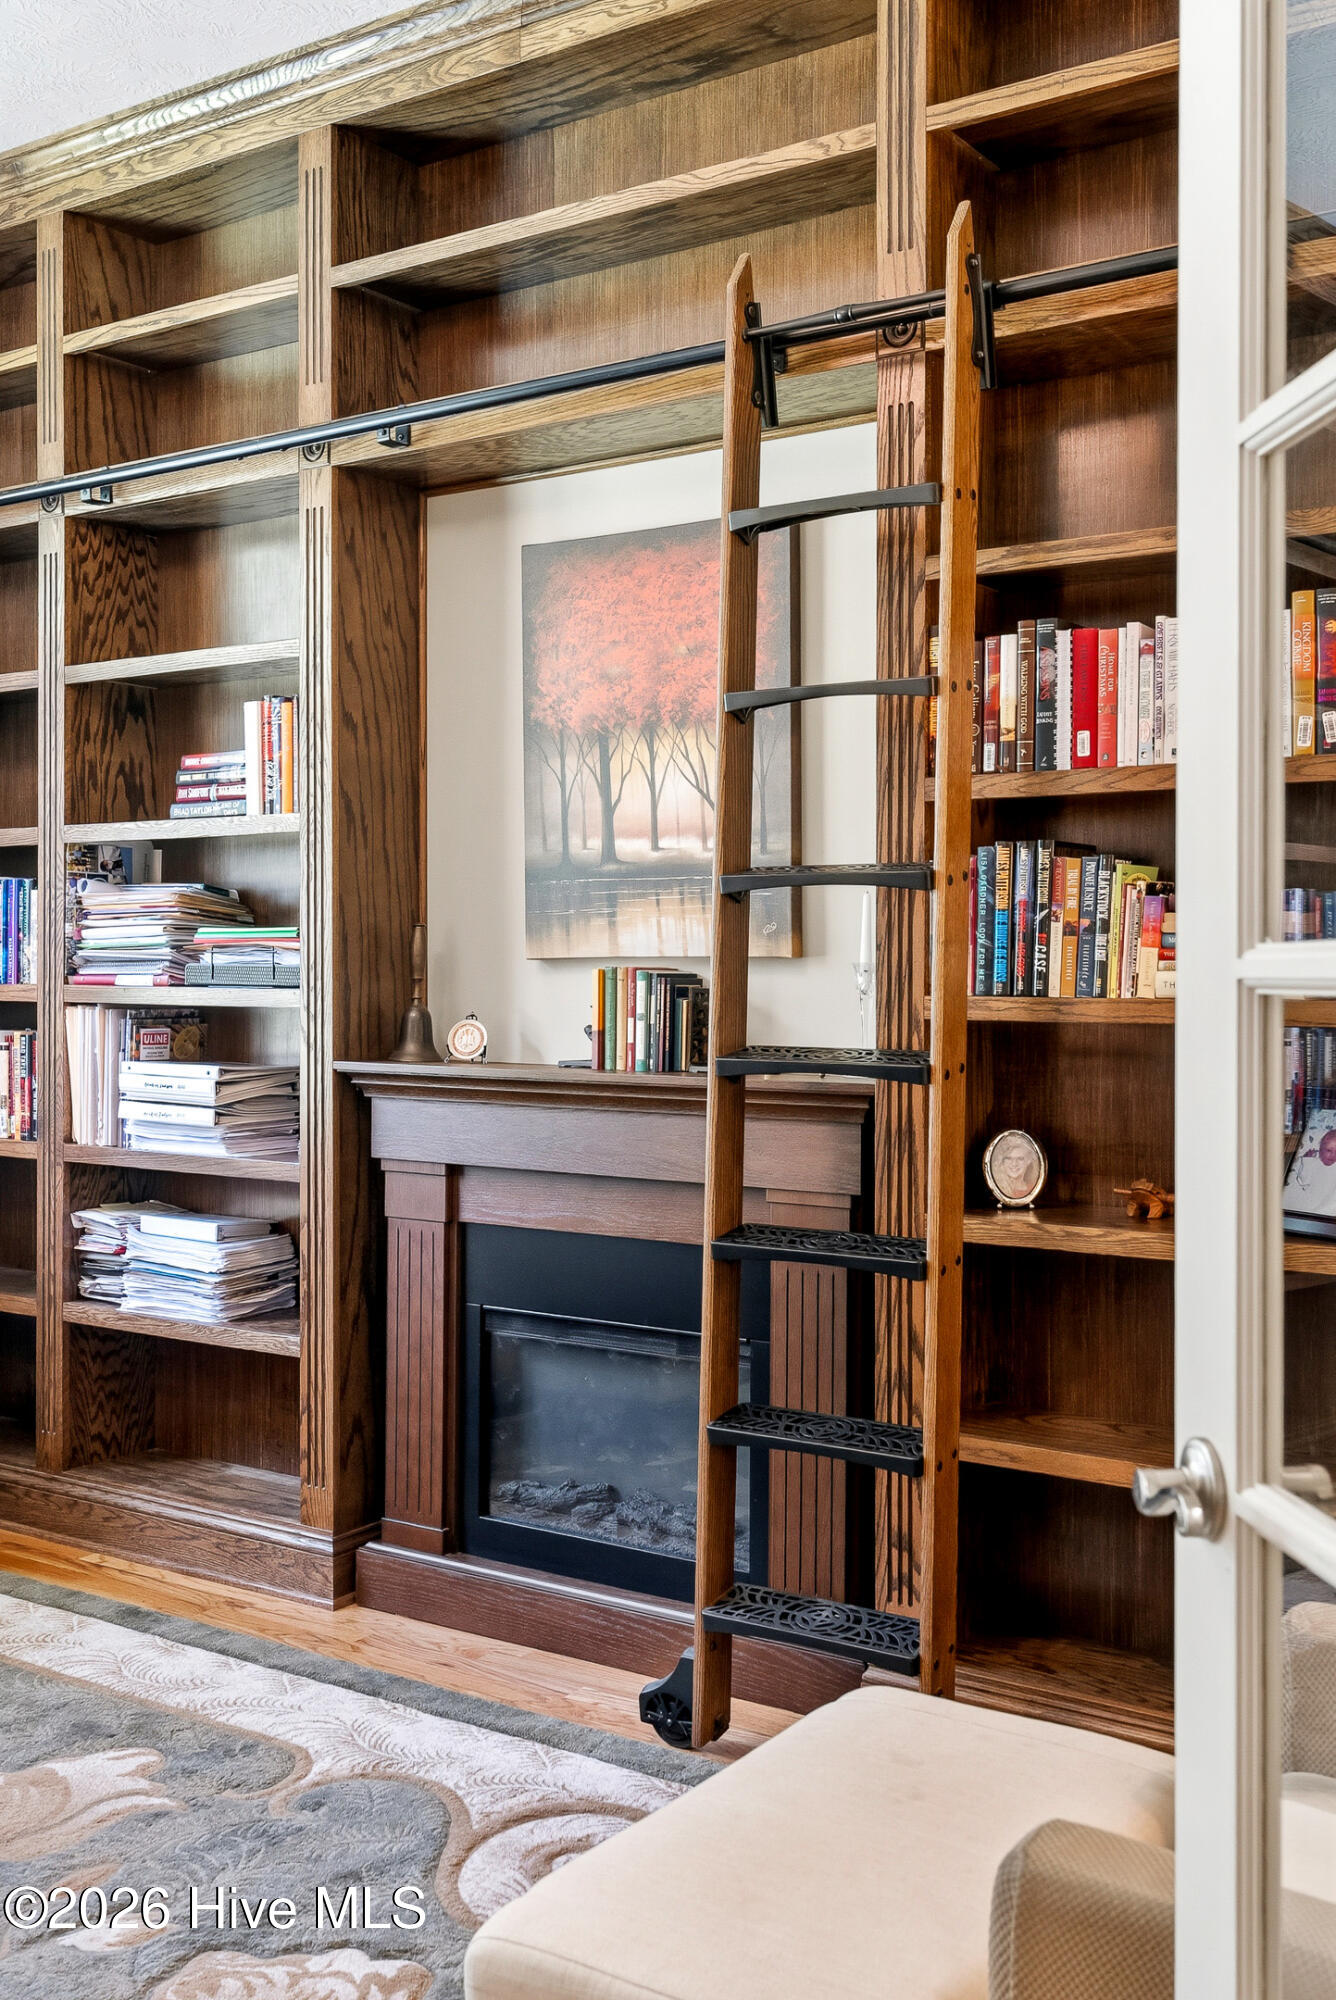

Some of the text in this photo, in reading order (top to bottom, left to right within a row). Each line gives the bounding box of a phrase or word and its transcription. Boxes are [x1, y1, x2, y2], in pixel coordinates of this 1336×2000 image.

[1294, 629, 1302, 666] COME
[1302, 621, 1312, 672] KINGDOM
[1099, 645, 1110, 697] CHRISTMAS
[1107, 651, 1115, 675] HOME
[1020, 659, 1029, 734] WALKING WITH GOD
[980, 851, 988, 871] LISA
[996, 846, 1011, 870] JAMES
[996, 871, 1010, 910] PATTERSON
[1067, 869, 1079, 887] TRIAL
[1097, 870, 1110, 920] BLACKSTOCK
[978, 948, 986, 966] FOR
[1035, 945, 1048, 973] CASE
[978, 969, 986, 982] ME
[143, 1033, 169, 1045] ULINE
